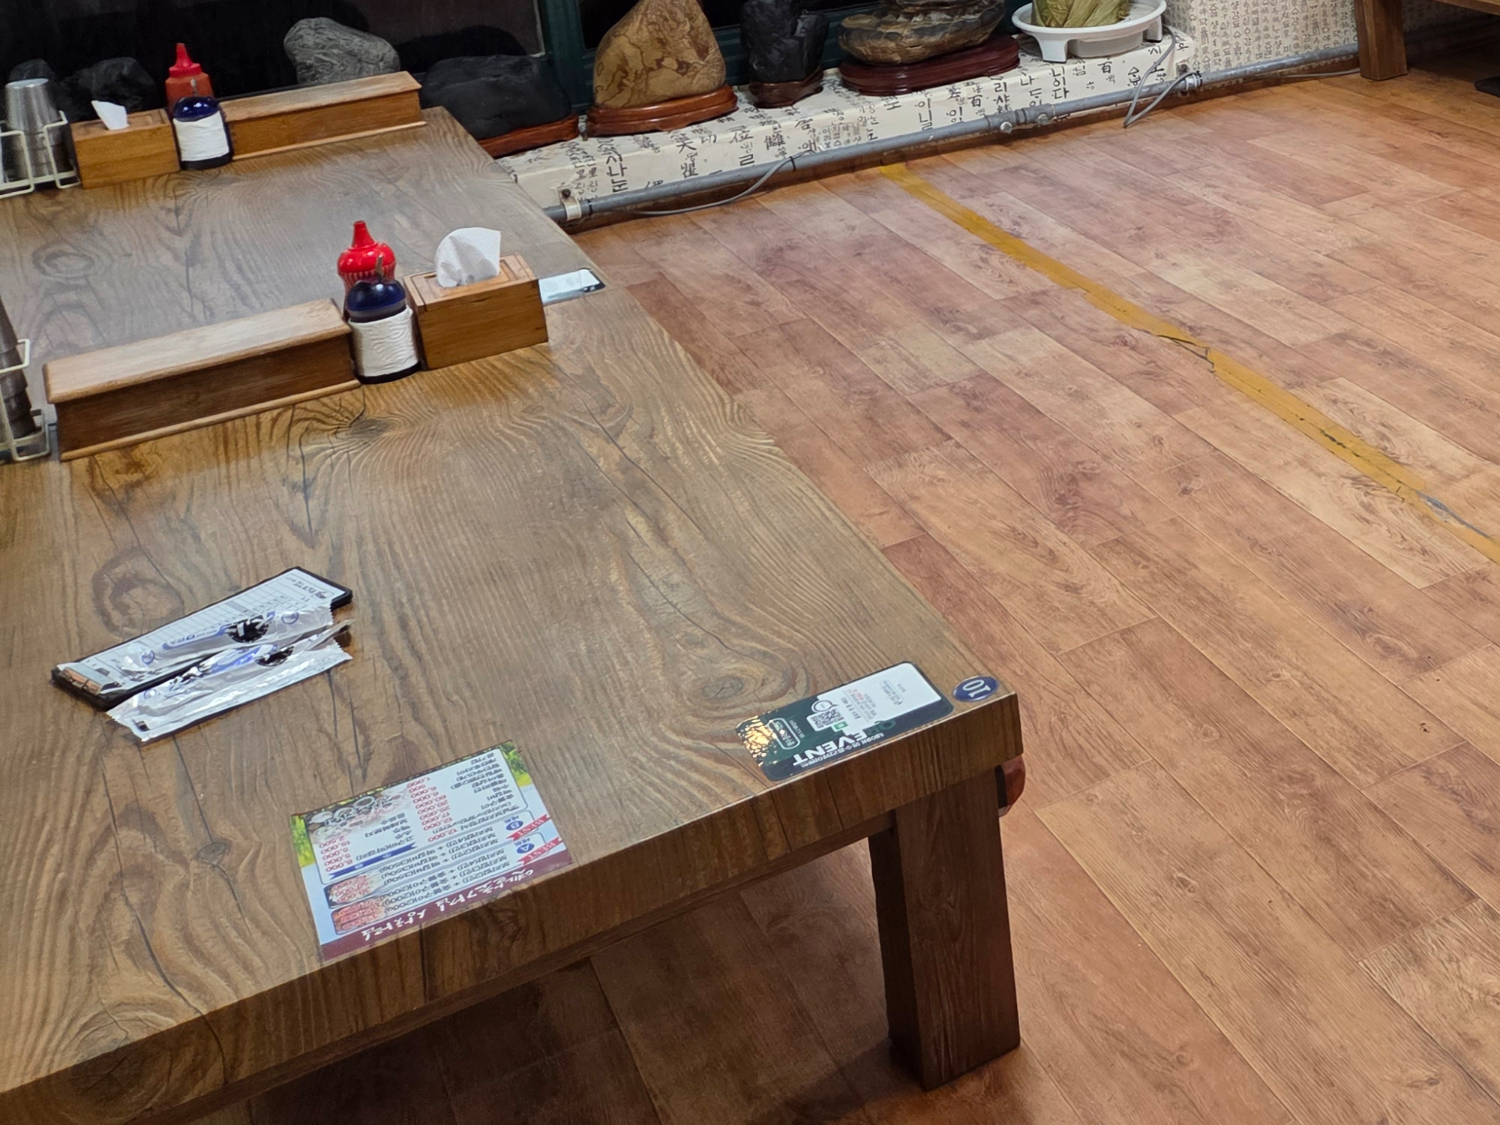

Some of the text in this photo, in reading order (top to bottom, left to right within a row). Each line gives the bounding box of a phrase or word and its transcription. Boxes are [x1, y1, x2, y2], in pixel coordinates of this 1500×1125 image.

[787, 728, 868, 766] EVENT
[526, 841, 556, 860] BEST
[359, 905, 428, 944] 상차림
